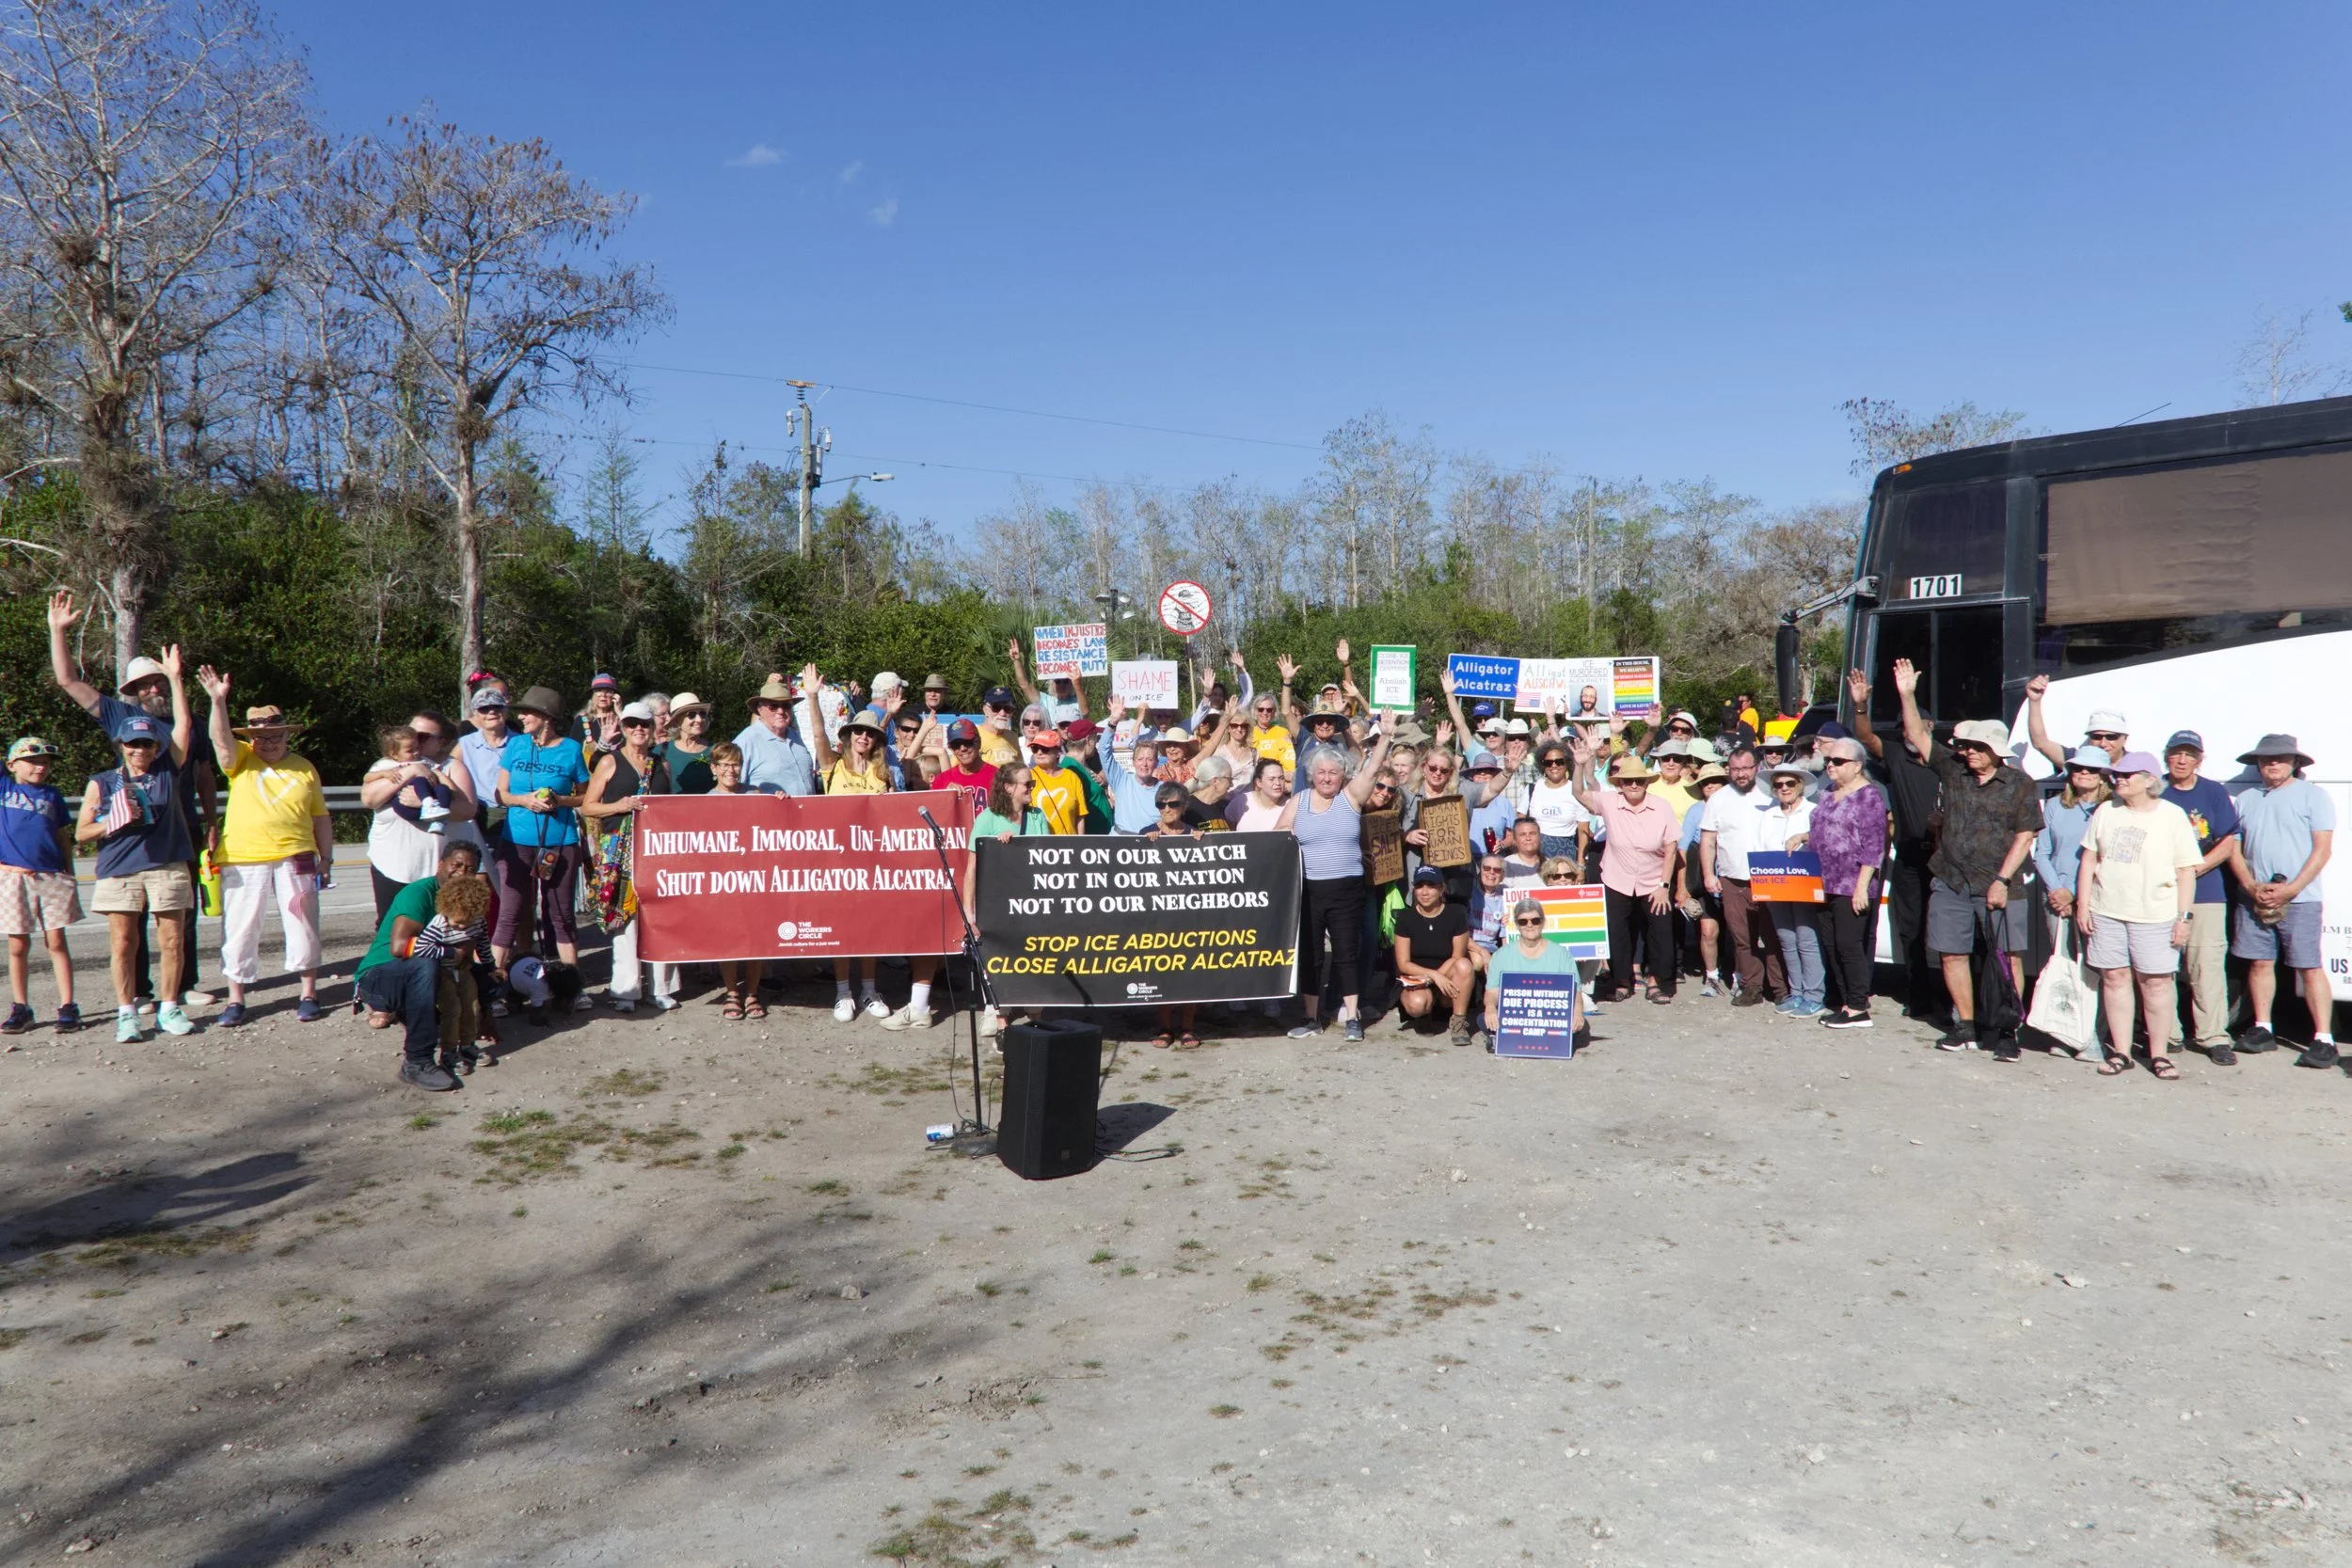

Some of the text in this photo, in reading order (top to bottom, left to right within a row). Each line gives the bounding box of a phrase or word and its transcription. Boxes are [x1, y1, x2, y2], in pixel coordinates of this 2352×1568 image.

[1914, 576, 1959, 597] 1701
[1035, 627, 1064, 639] WHEN
[1037, 637, 1107, 650] BECOMES LAW
[1038, 648, 1105, 662] RESISTANCE
[1037, 659, 1107, 674] BECOMES DUTY
[1455, 661, 1514, 676] Alligator
[1582, 659, 1595, 668] ICE
[1569, 668, 1608, 676] MURDERED
[1119, 670, 1172, 692] SHAME
[1457, 678, 1511, 691] Alcatraz
[515, 761, 564, 774] RESIST
[1428, 828, 1456, 838] FOR
[1371, 832, 1400, 857] SALT
[1028, 845, 1247, 864] NOT ON OUR WATCH
[1428, 847, 1465, 863] BEINGS
[1787, 866, 1809, 876] Love,
[1033, 867, 1245, 889] NOT IN OUR NATION
[1009, 891, 1269, 914] NOT TO OUR NEIGHBORS
[1505, 890, 1528, 903] LOVE
[1025, 929, 1257, 952] STOP ICE ABDUCTIONS
[987, 948, 1296, 974] CLOSE ALLIGATOR ALCATRAZ
[2331, 958, 2348, 974] US
[1534, 990, 1569, 998] WITHOUT
[1503, 998, 1568, 1009] DUE PROCESS
[1536, 1009, 1543, 1018] A
[1502, 1018, 1568, 1028] CONCENTRATION
